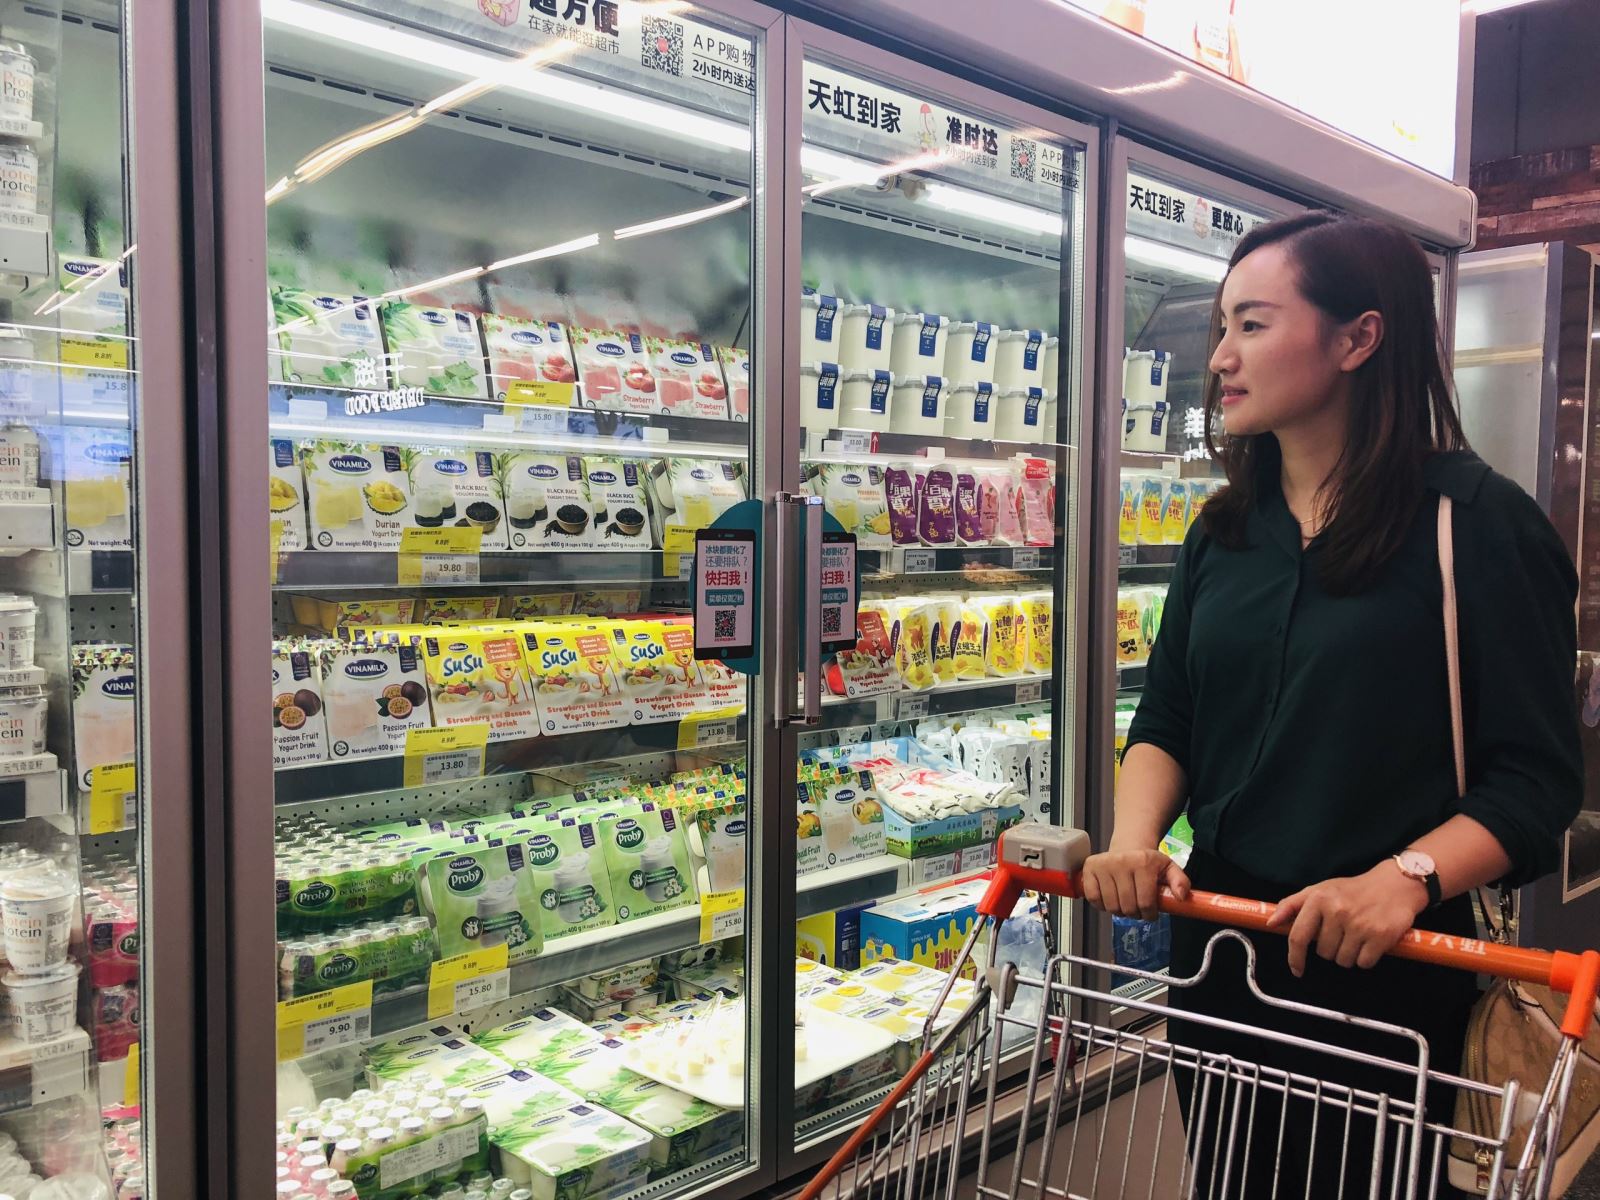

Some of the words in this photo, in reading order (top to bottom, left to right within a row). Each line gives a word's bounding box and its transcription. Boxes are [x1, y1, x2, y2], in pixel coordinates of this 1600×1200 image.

[692, 59, 756, 91] 2小时内送达
[808, 79, 901, 134] 天虹到家
[945, 115, 998, 156] 准时达
[1130, 184, 1185, 224] 天虹到家
[1211, 206, 1244, 236] 更放心
[623, 395, 655, 405] Strawberry
[695, 402, 725, 411] Strawberry
[331, 460, 369, 469] VINAMILK
[436, 463, 467, 472] VINAMILK
[530, 467, 558, 477] VINAMILK
[590, 473, 616, 481] VINAMILK
[375, 519, 401, 529] Durian
[439, 563, 461, 572] 19.80
[630, 643, 664, 662] SuSu
[542, 649, 577, 669] SuSu
[347, 663, 386, 673] VINAMILK
[443, 655, 484, 677] SuSu
[635, 696, 672, 704] Strawberry
[547, 704, 586, 713] Strawberry
[650, 703, 675, 712] Yogurt
[504, 709, 531, 718] Banana
[564, 713, 589, 722] Yogurt
[590, 709, 611, 718] Drink
[383, 723, 407, 732] Passion
[408, 721, 425, 730] Fruit
[301, 732, 319, 740] Fruit
[278, 743, 299, 752] Yogurt
[440, 760, 464, 771] 13.80
[528, 836, 551, 845] VINAMILK
[618, 829, 642, 844] Proby
[868, 831, 882, 841] Fruit
[529, 846, 556, 862] Proby
[807, 844, 821, 856] Fruit
[450, 858, 475, 868] VINAMILK
[450, 868, 481, 887] Proby
[299, 888, 331, 902] Proby
[725, 917, 742, 928] 15.80
[469, 983, 492, 996] 15.80
[329, 1022, 350, 1035] 9.90
